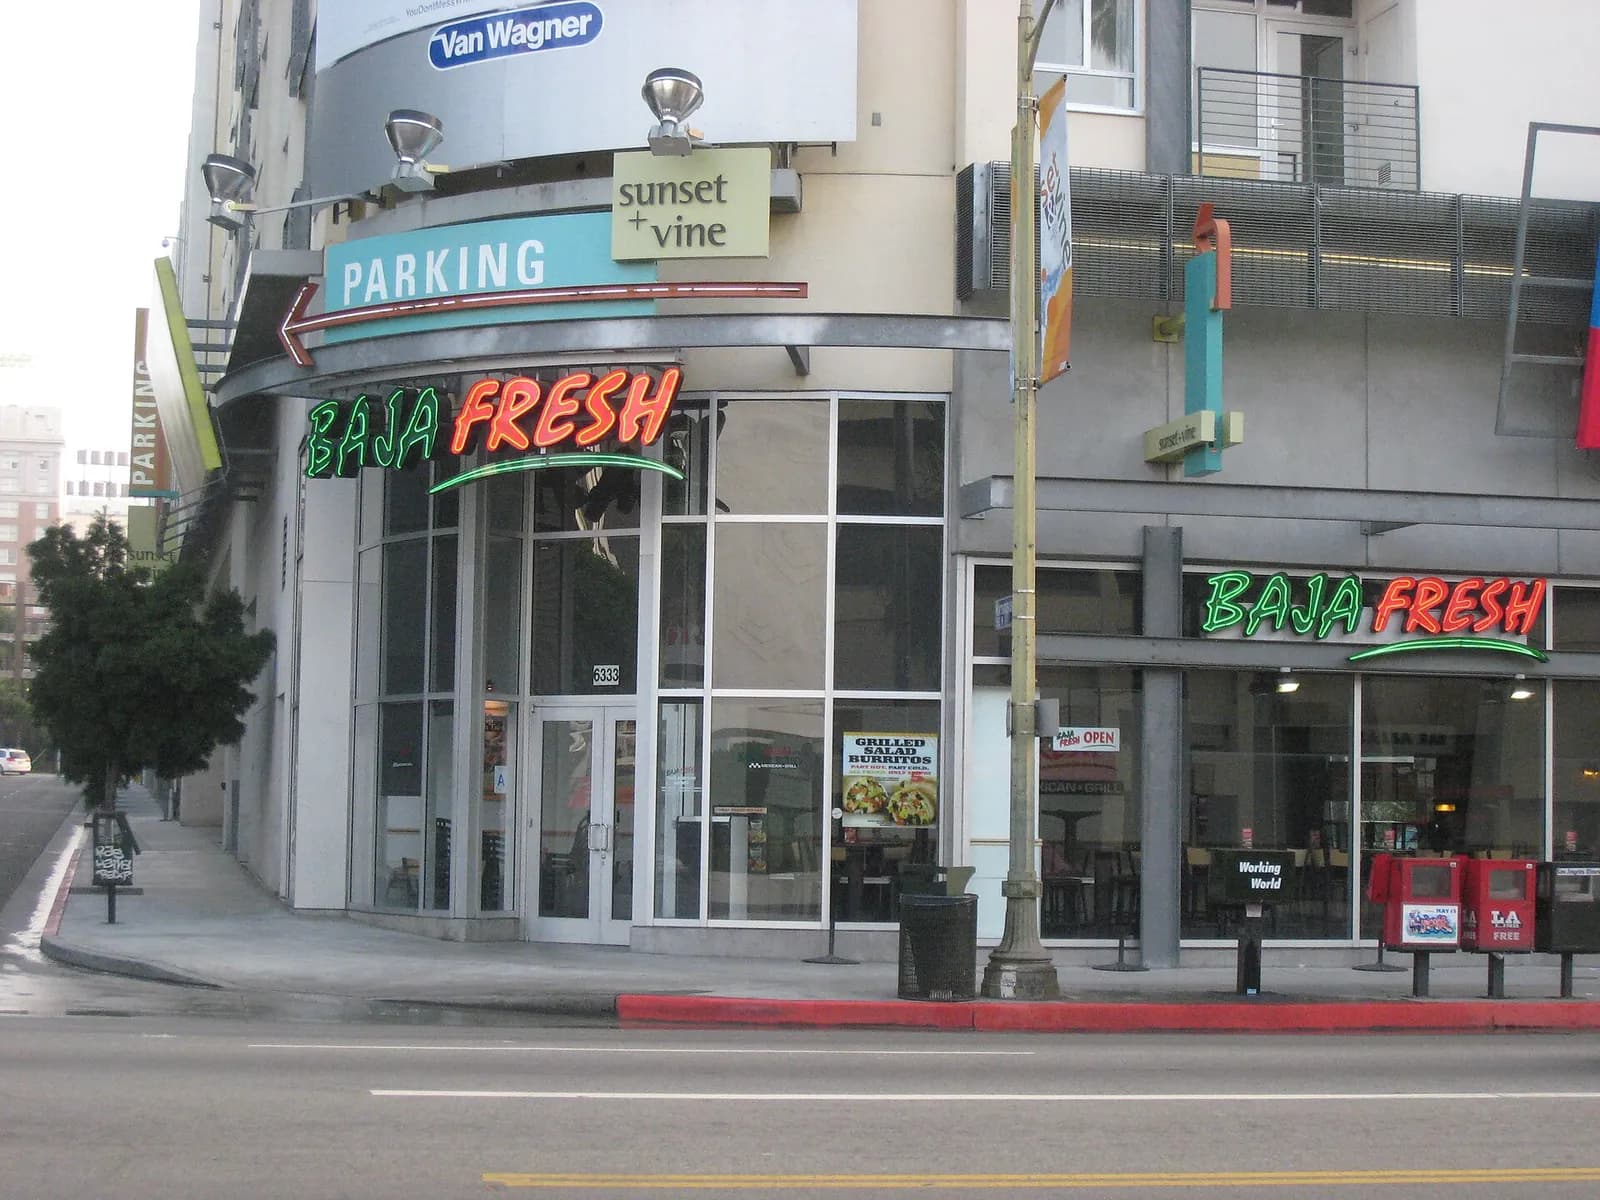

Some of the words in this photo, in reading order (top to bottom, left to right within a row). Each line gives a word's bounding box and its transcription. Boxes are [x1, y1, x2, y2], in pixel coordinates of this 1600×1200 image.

[431, 30, 484, 58] Van
[486, 13, 593, 49] Wagner
[618, 174, 728, 206] sunset
[650, 214, 727, 248] vine
[343, 238, 546, 306] PARKING
[131, 359, 157, 486] PARKING
[305, 386, 440, 478] BAJA
[449, 366, 682, 456] FRESH
[1201, 570, 1365, 640] BAJA
[1372, 576, 1547, 636] FRESH
[593, 666, 619, 683] 6333
[855, 738, 926, 748] GRILLED
[1060, 736, 1081, 747] FRESH
[1083, 731, 1114, 743] OPEN
[863, 746, 917, 756] SALAD
[848, 755, 932, 765] BURRITOS
[1239, 861, 1281, 875] Working
[1251, 877, 1281, 890] World
[1493, 931, 1520, 941] FREE
